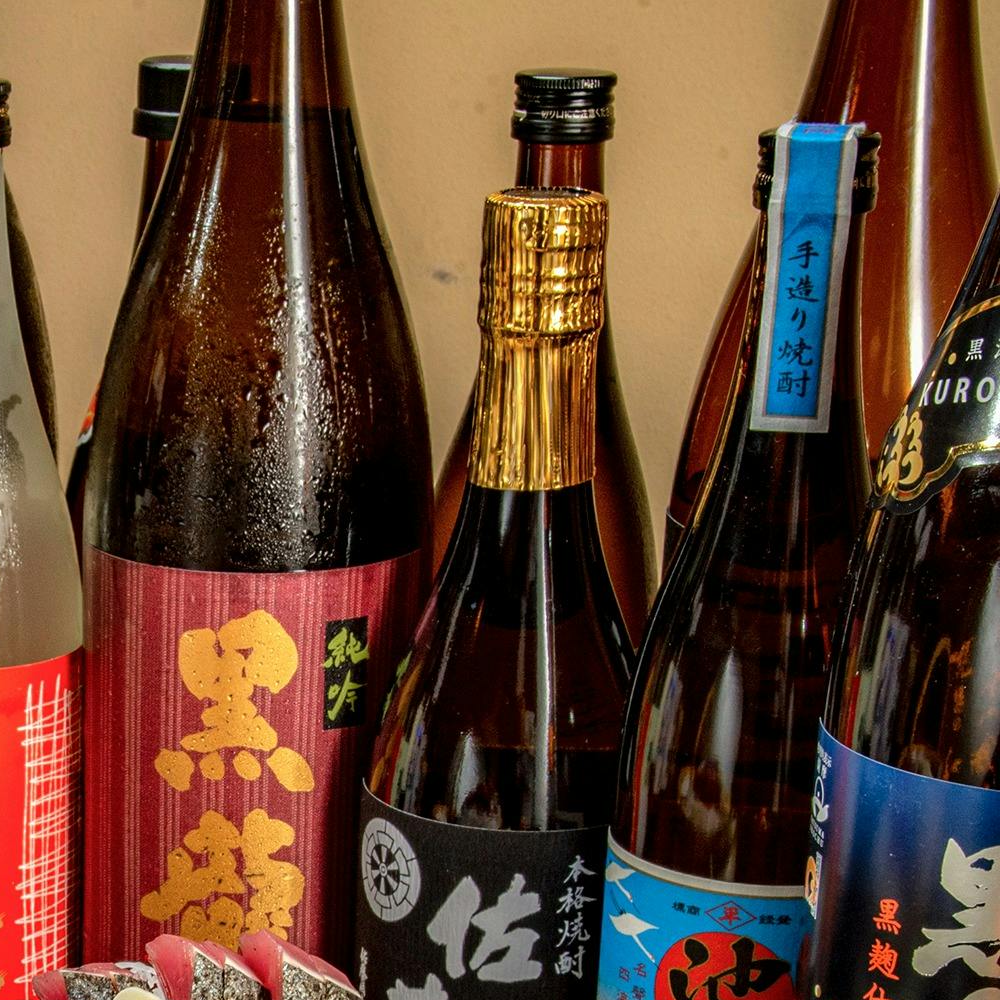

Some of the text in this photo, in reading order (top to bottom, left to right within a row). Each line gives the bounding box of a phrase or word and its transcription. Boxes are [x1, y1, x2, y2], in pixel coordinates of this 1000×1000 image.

[776, 239, 820, 399] 手造り焼酎
[918, 376, 997, 408] KURO
[323, 626, 369, 721] 純吟
